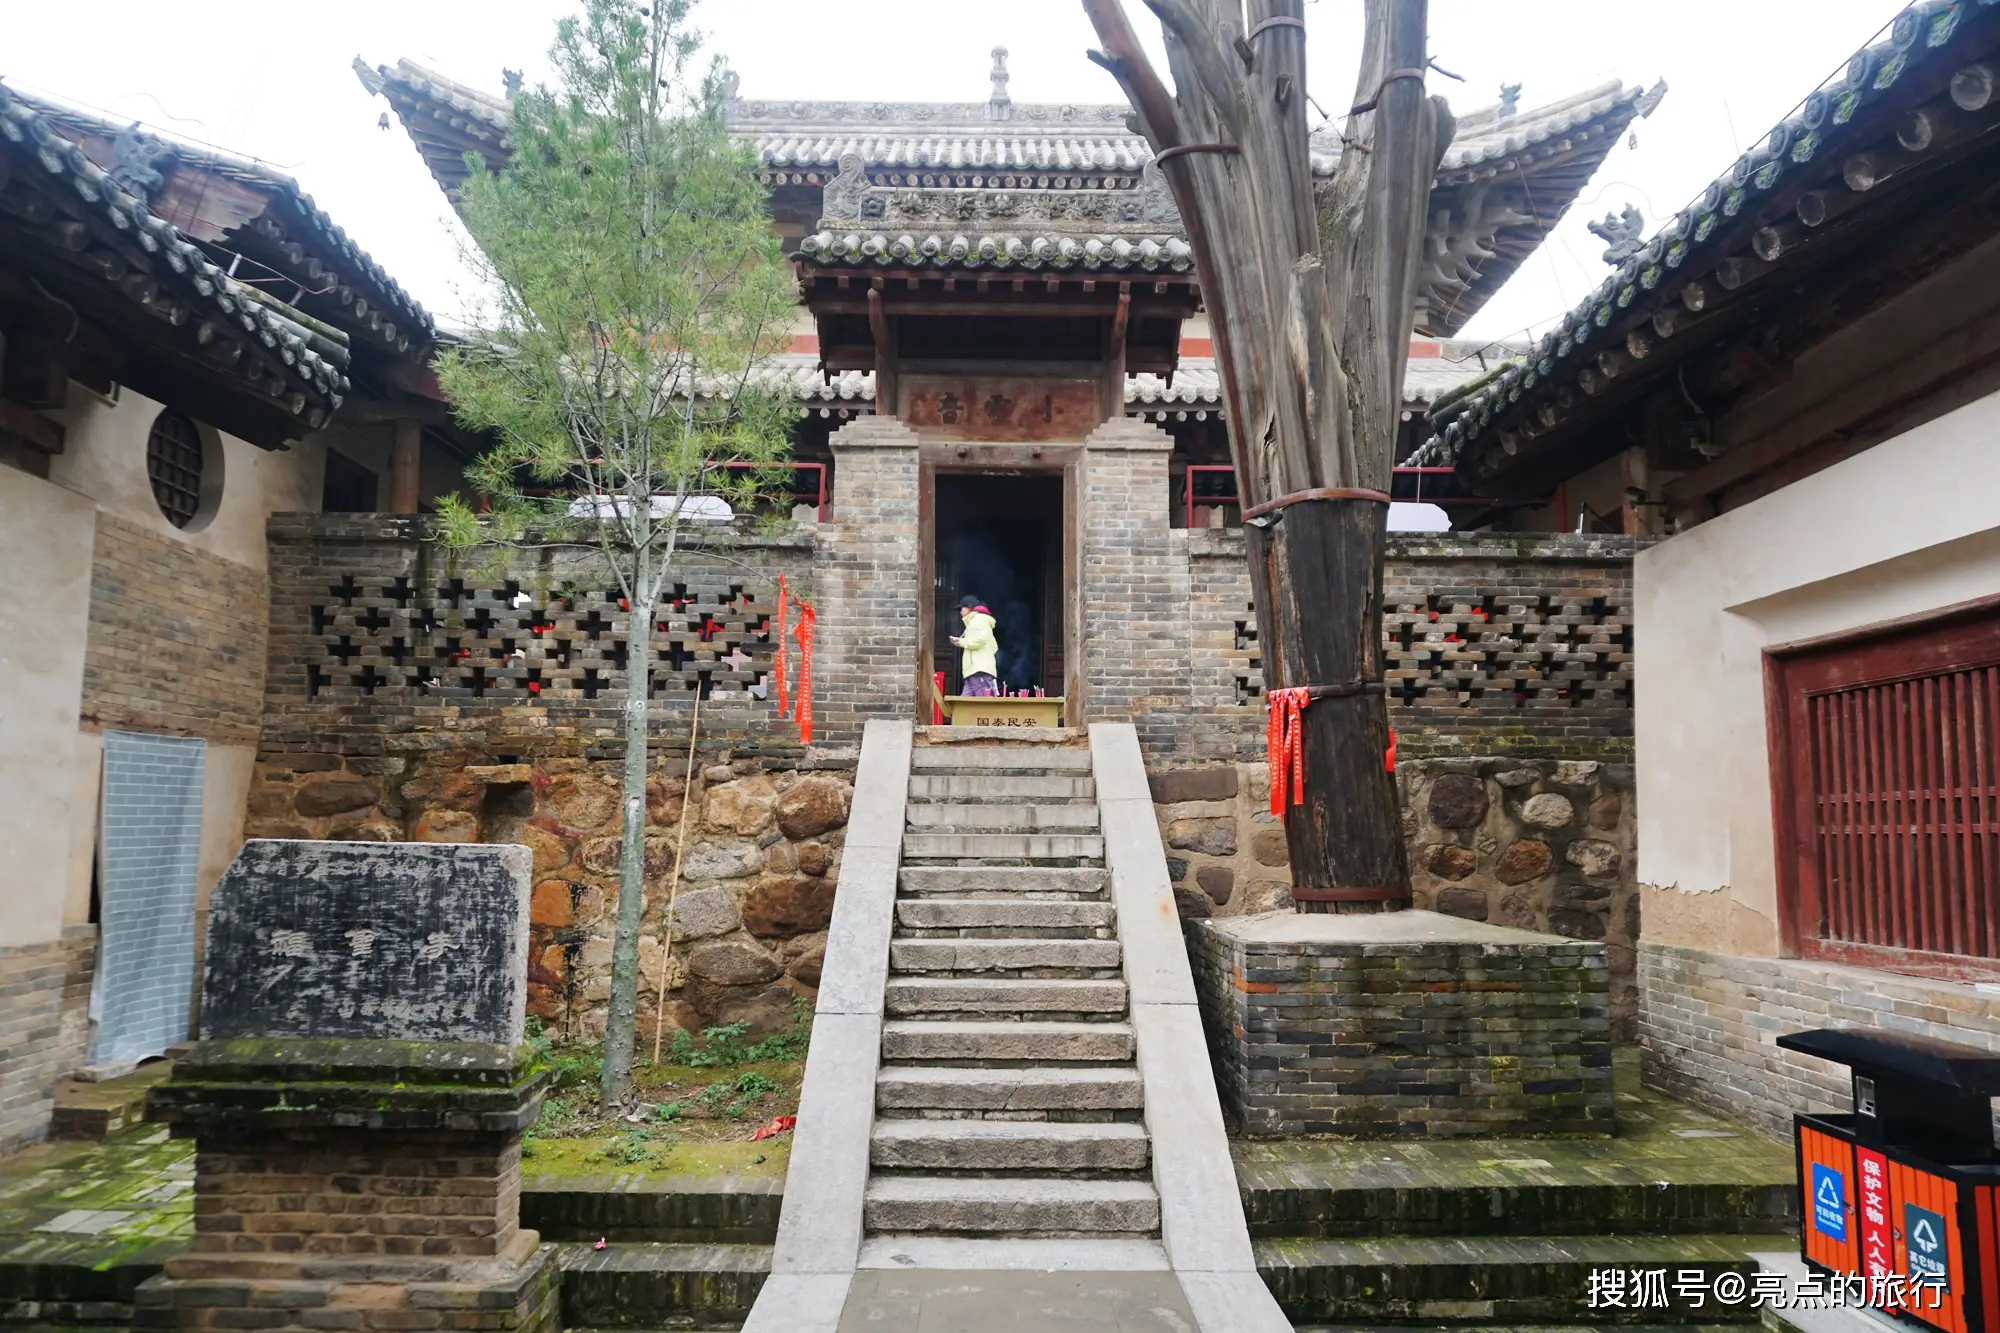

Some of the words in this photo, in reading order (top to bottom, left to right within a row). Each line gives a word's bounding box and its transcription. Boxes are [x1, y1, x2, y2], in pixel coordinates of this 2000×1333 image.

[977, 717, 1037, 727] 国泰民安
[1863, 1158, 1884, 1226] 保护文物
